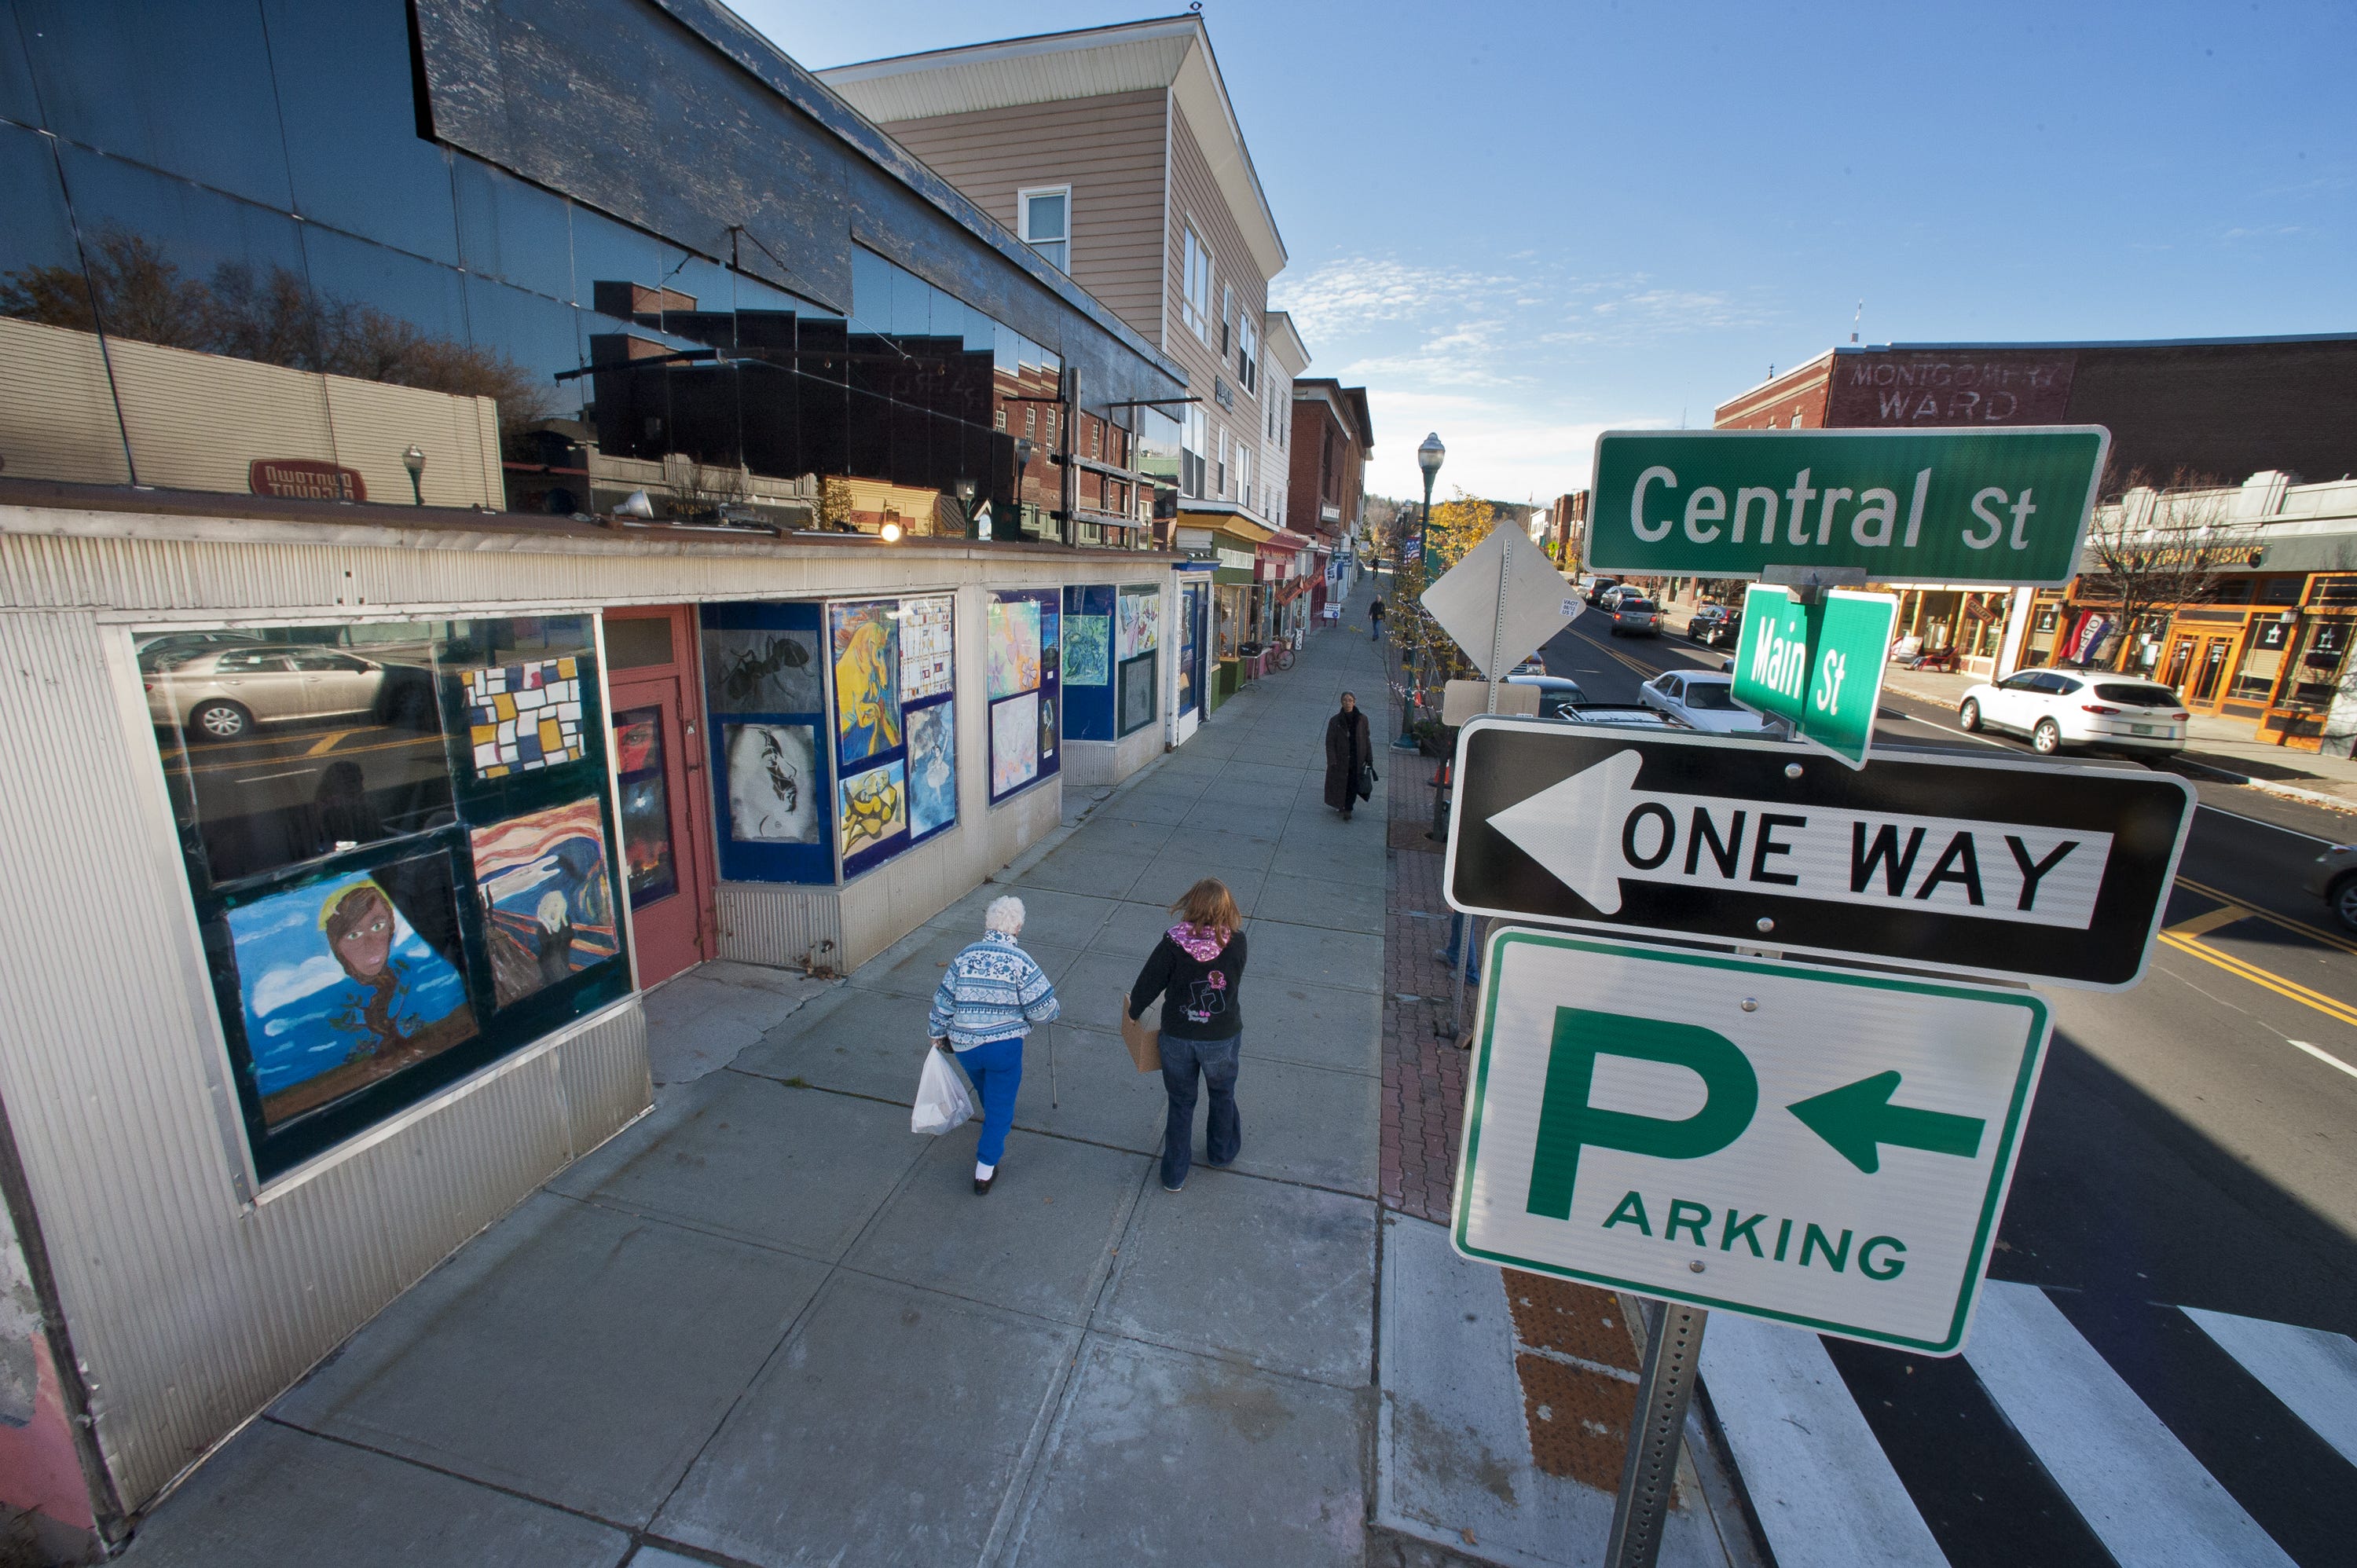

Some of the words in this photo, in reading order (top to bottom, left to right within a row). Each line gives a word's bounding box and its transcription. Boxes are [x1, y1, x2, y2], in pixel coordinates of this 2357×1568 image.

[1879, 390, 2018, 421] WARD
[1630, 465, 1932, 548] Central
[1962, 486, 2037, 550] St
[1969, 601, 1992, 624] GALLERY
[1750, 616, 1806, 699] Main
[1816, 649, 1846, 716] St
[1621, 801, 1808, 887] ONE
[1849, 821, 2082, 912] WAY
[1526, 1005, 1908, 1281] PARKING
